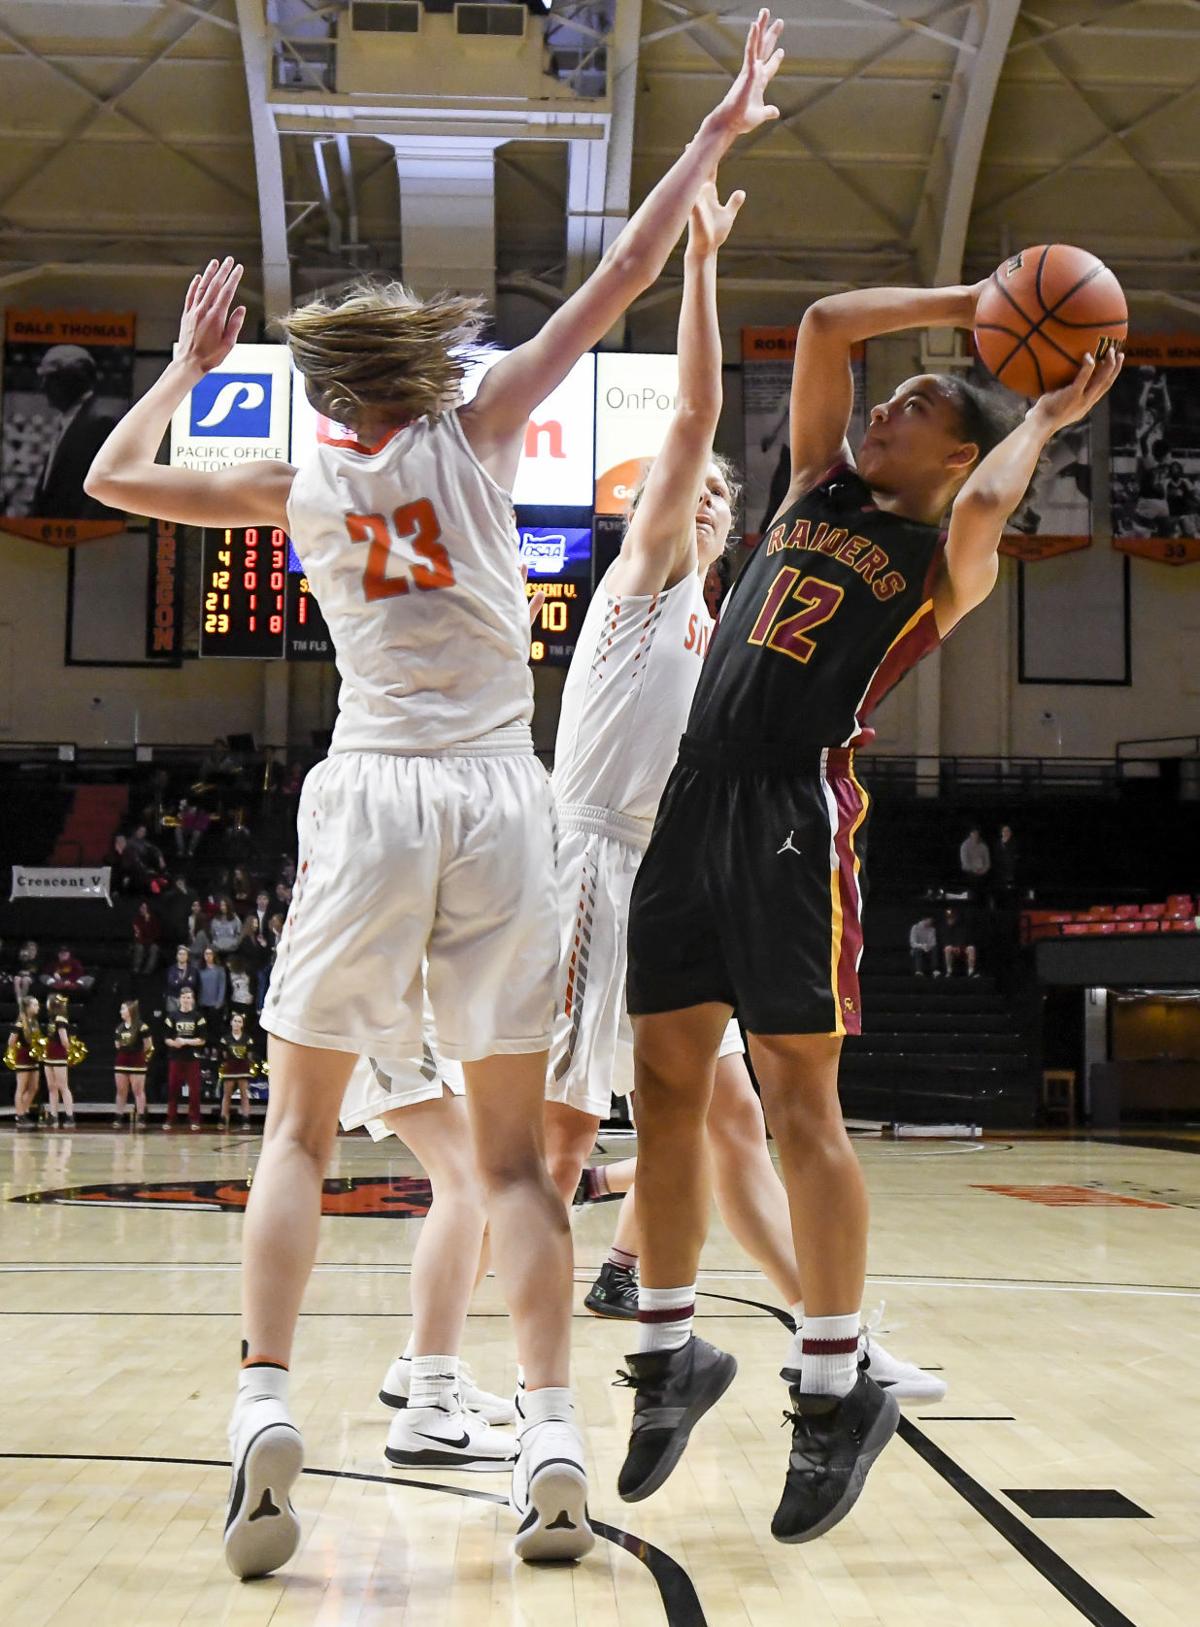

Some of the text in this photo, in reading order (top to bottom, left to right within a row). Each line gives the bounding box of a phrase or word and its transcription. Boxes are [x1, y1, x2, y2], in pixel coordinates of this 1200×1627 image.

[176, 446, 283, 460] PACIFIC OFFICE
[224, 528, 284, 548] 1 0 0
[218, 551, 284, 568] 4 2 3
[344, 496, 457, 603] 23
[766, 518, 907, 602] RAIDERS
[212, 571, 283, 591] 12 0 0
[205, 592, 283, 611] 21 1 1
[204, 613, 283, 634] 23 1 8
[541, 601, 567, 631] 10
[747, 564, 845, 665] 12
[531, 641, 545, 660] 8
[17, 876, 84, 888] Crescent
